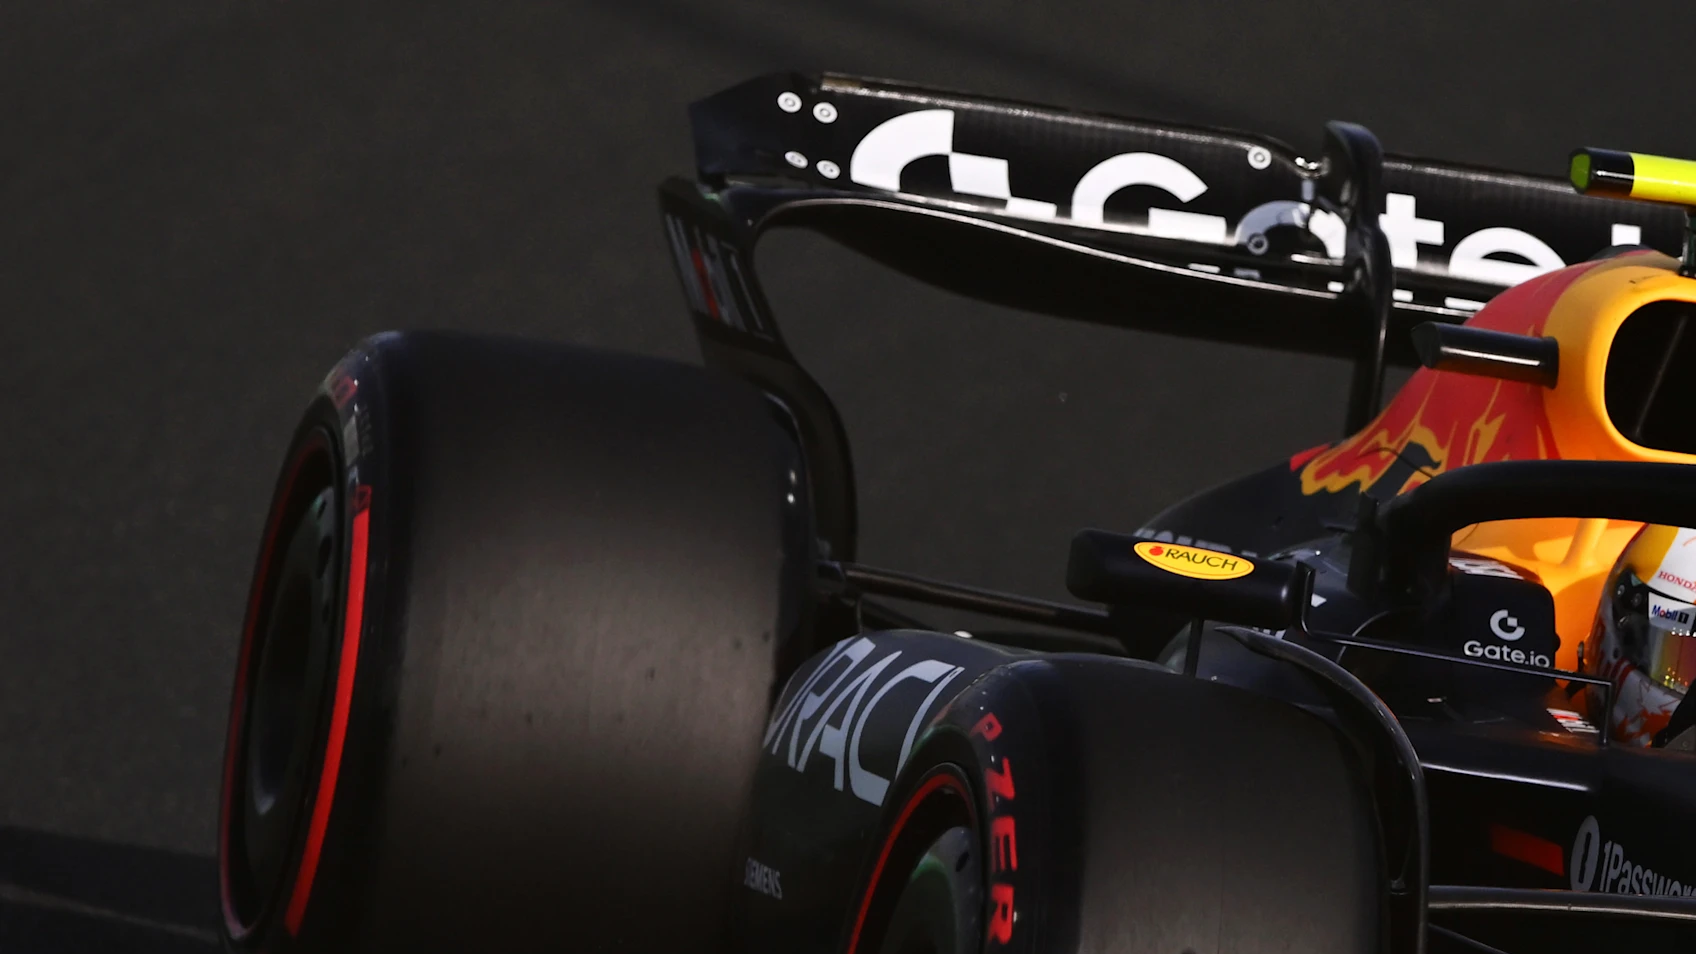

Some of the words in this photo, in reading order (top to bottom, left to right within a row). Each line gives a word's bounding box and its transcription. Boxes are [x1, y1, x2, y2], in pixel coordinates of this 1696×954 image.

[1165, 548, 1239, 571] RAUCH
[1651, 604, 1678, 622] Mobil
[1463, 639, 1551, 668] Gate.io
[969, 711, 1003, 742] P
